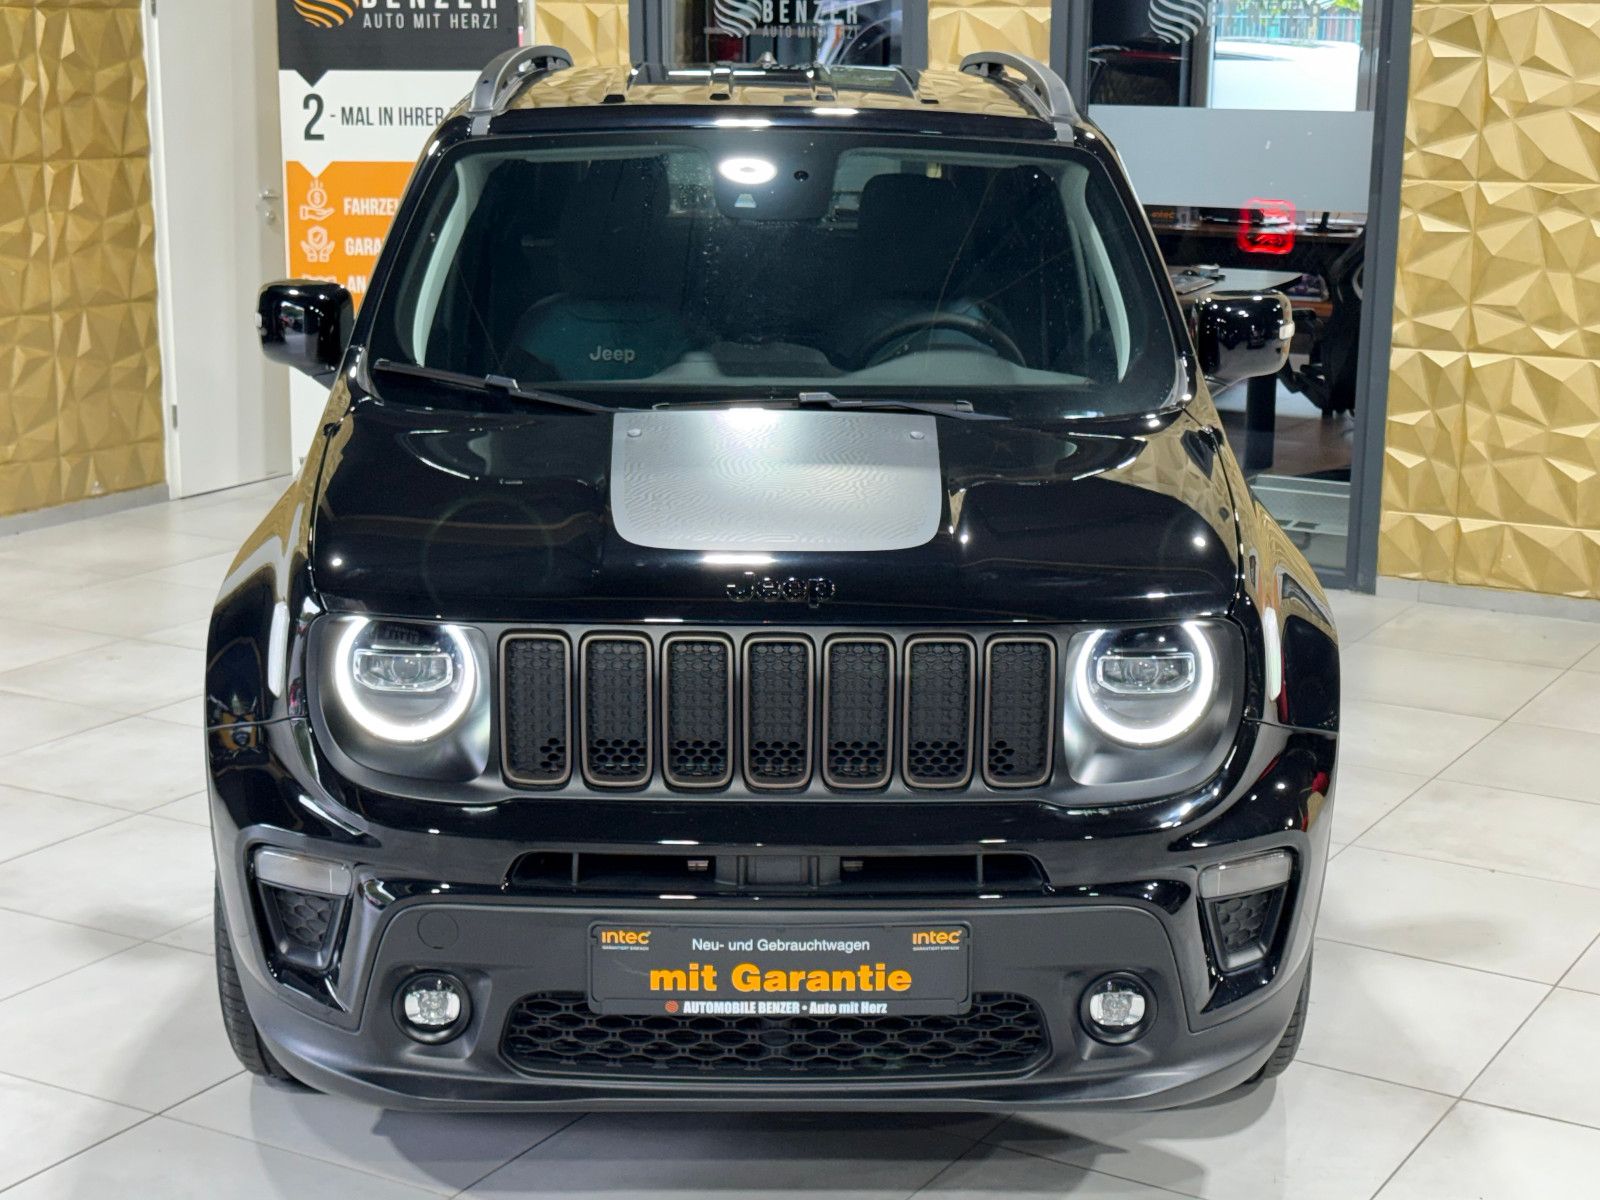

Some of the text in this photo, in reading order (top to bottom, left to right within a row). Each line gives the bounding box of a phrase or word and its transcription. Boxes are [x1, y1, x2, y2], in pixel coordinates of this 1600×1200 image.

[362, 13, 498, 29] AUTO MIT HERZ!
[762, 25, 792, 38] AUTO
[303, 93, 325, 141] 2
[341, 106, 374, 126] MAL
[378, 107, 393, 126] IN
[398, 107, 444, 126] IHRER
[344, 236, 384, 256] GARA
[589, 345, 635, 364] Jeep
[726, 571, 836, 608] Jeep
[601, 930, 651, 945] intec
[692, 938, 870, 953] Neu- und Gebrauchtwagen
[912, 930, 962, 945] intec
[650, 962, 912, 993] mit Garantie
[683, 1001, 888, 1015] AUTOMOBILE BENZER Auto mit Herz
